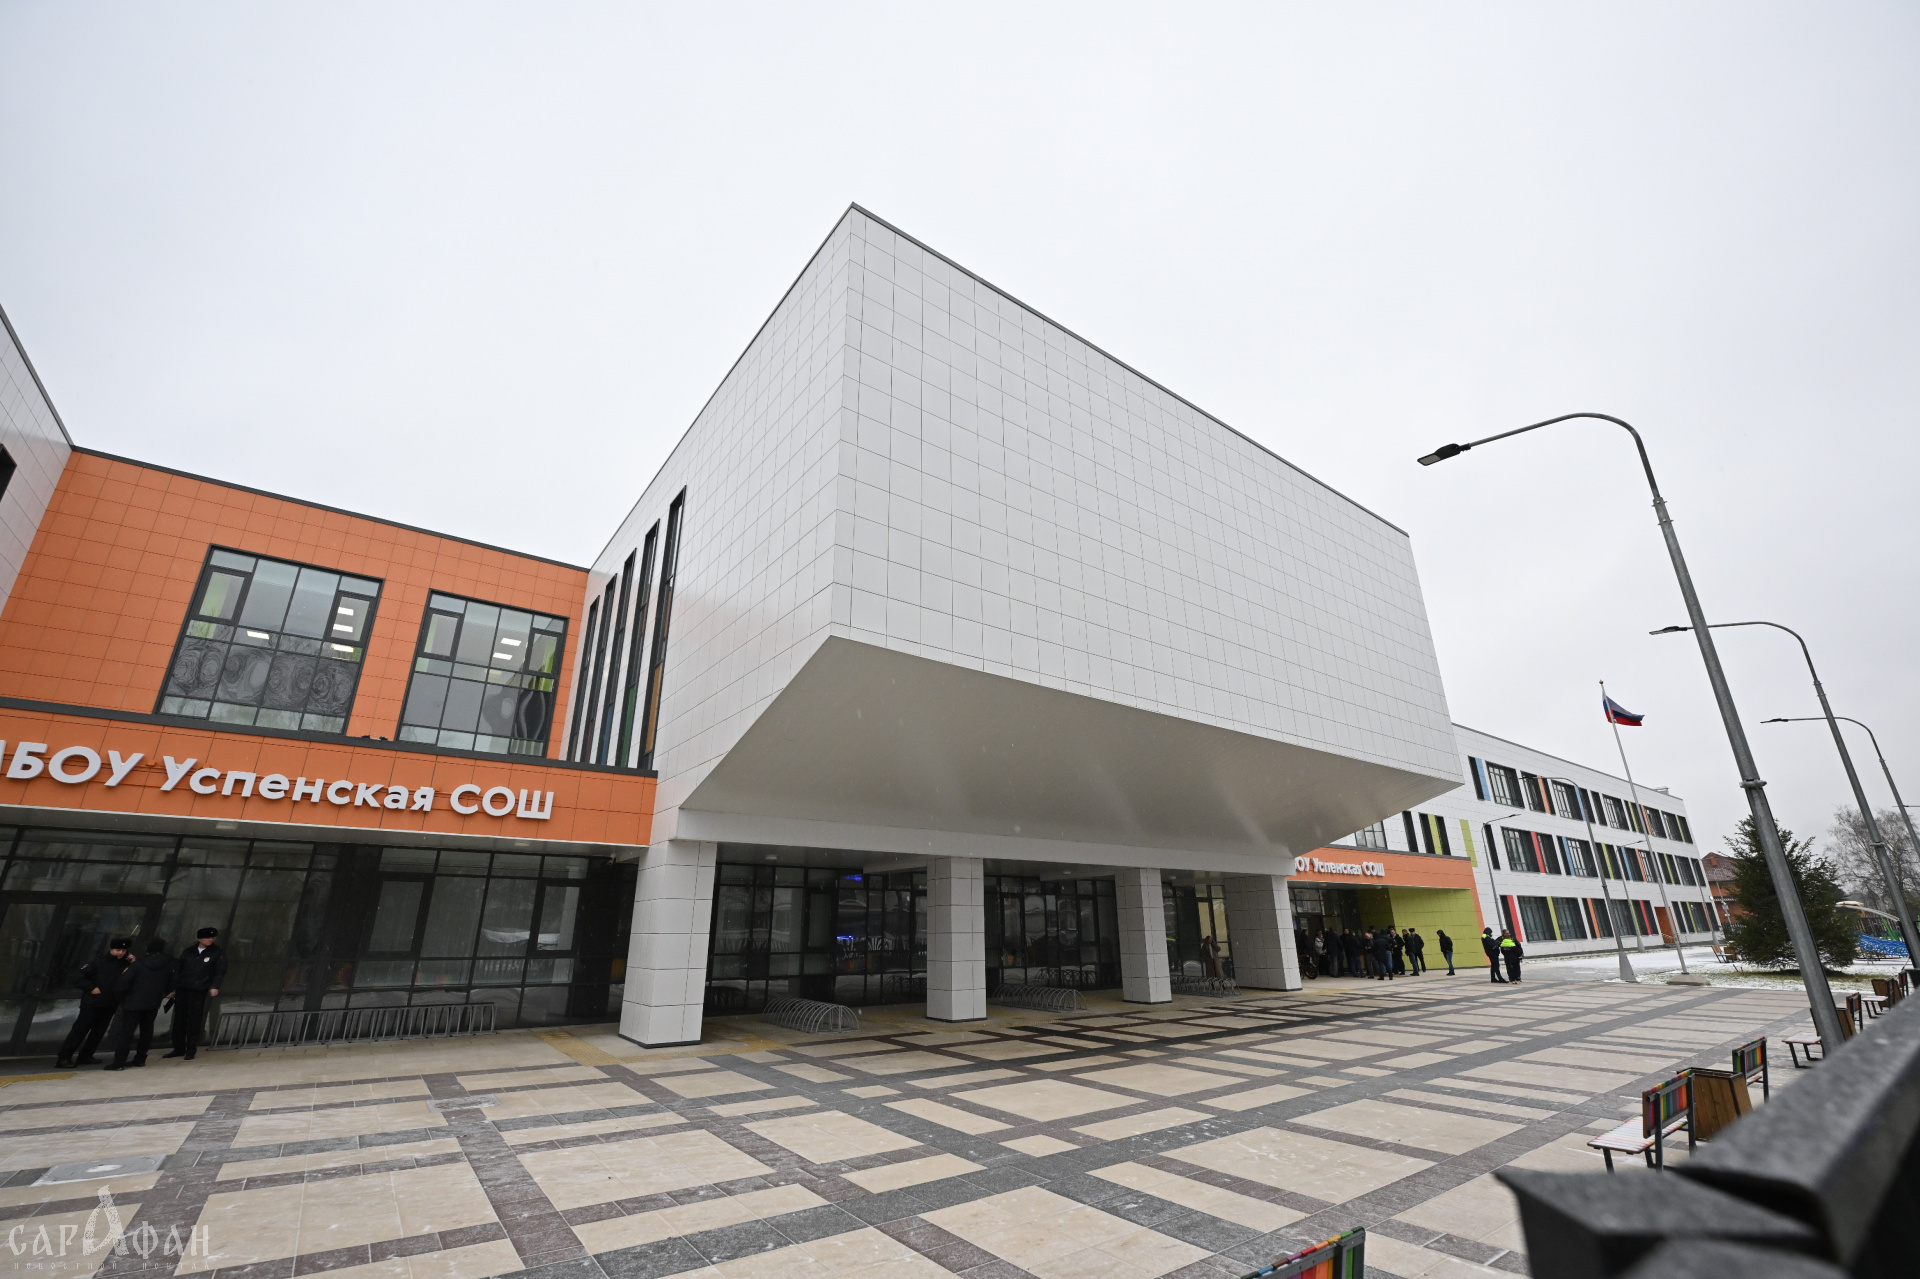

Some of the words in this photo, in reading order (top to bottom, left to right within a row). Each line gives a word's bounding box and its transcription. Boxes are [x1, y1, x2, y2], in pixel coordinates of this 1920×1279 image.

[0, 739, 145, 787] БОУ
[159, 755, 435, 812] Успенская
[449, 783, 555, 820] СОШ
[1294, 856, 1310, 872] ОУ
[1312, 857, 1362, 875] Успенская
[1362, 861, 1385, 877] СОШ
